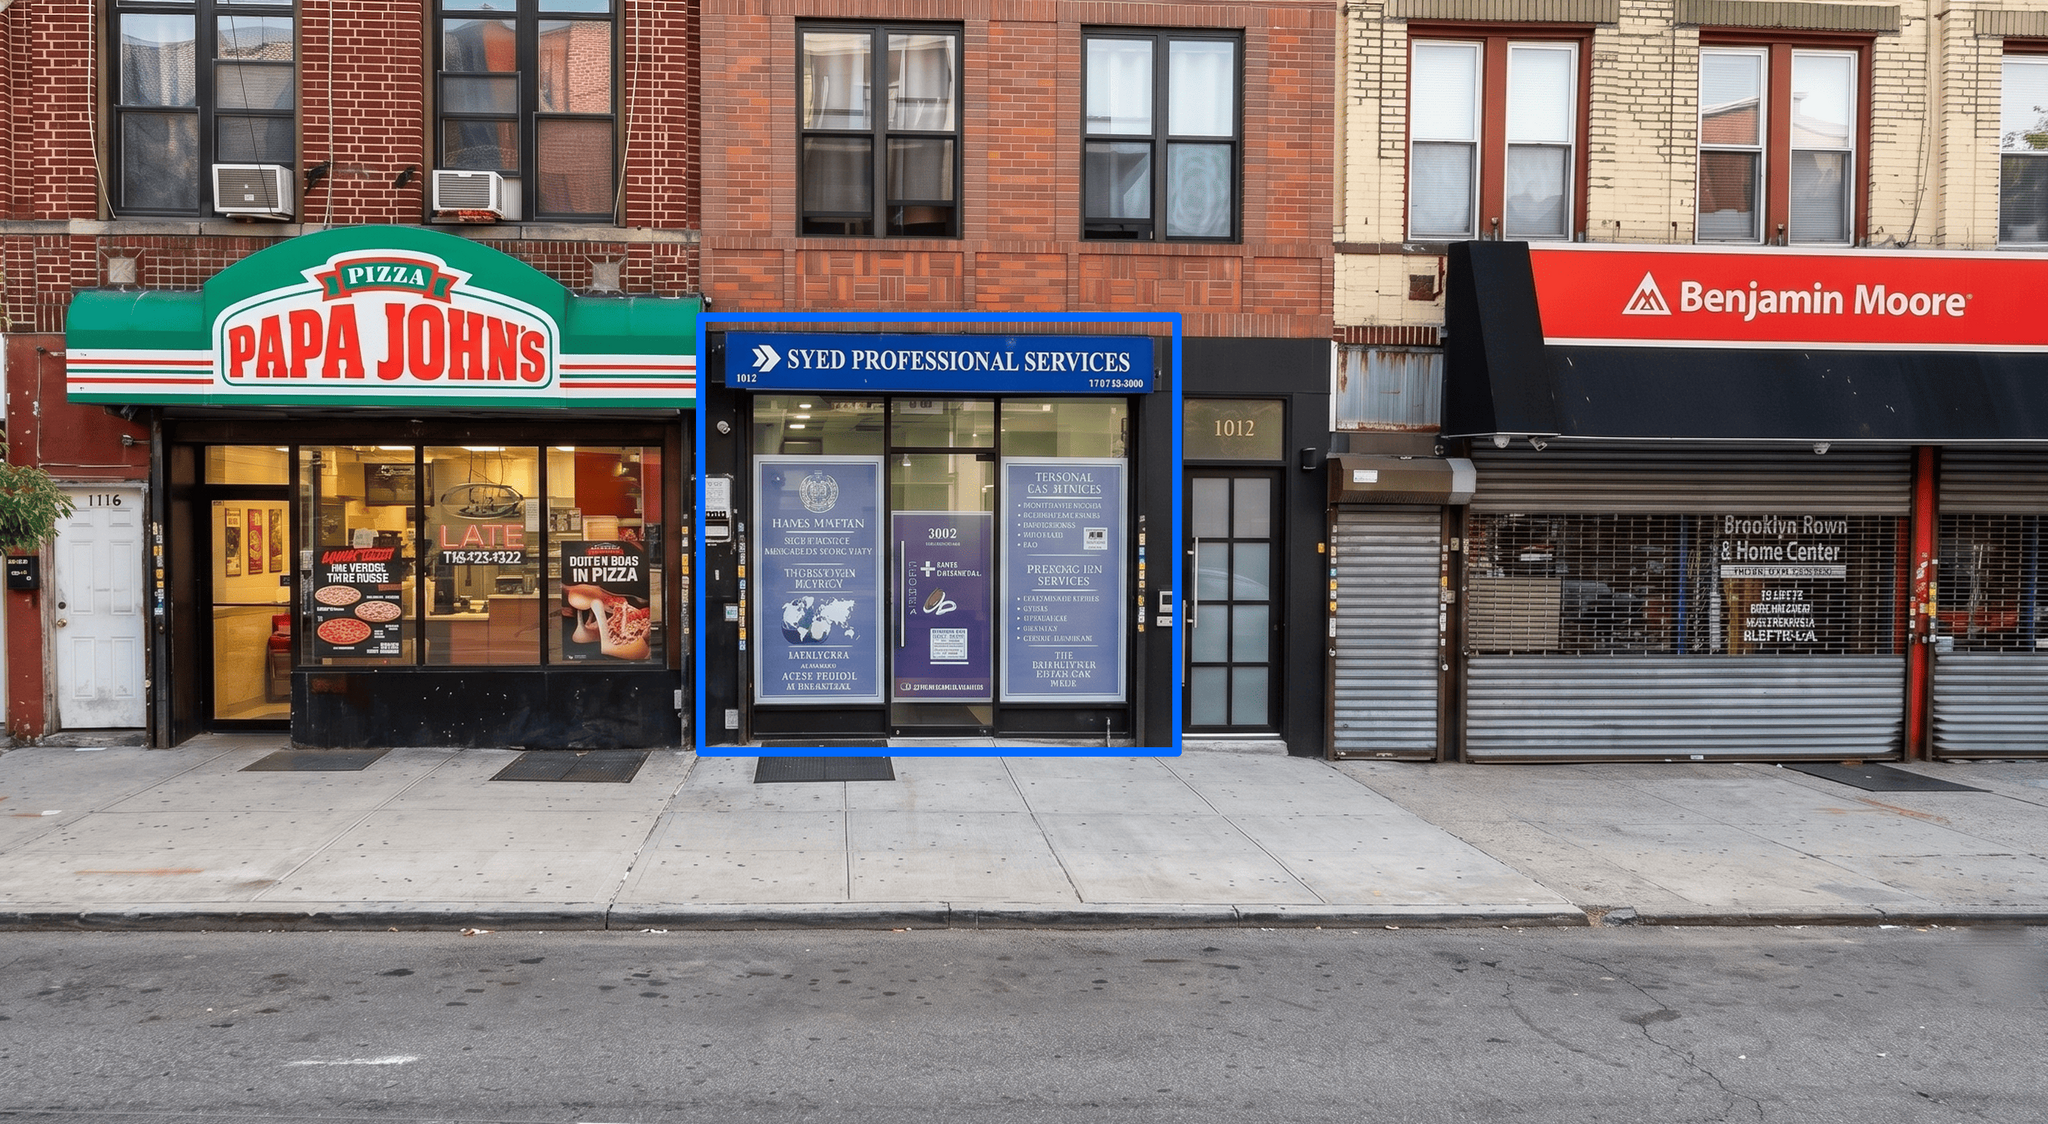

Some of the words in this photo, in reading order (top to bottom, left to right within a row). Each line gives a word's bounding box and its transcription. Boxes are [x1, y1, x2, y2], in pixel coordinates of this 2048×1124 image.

[347, 266, 426, 287] PIZZA
[1680, 280, 1844, 322] Benjamin
[1853, 284, 1967, 317] Moore
[228, 303, 366, 380] PAPA
[377, 302, 546, 383] JOHN'S
[787, 348, 846, 370] SYED
[851, 349, 1019, 372] PROFESSIONAL
[1024, 351, 1131, 373] SERVICES
[736, 373, 758, 383] 1012
[1214, 419, 1255, 437] 1012
[89, 494, 122, 507] 1116
[928, 527, 957, 539] 3002
[1724, 514, 1797, 540] Brooklyn
[1803, 515, 1848, 535] Rown
[440, 524, 525, 550] LATE
[1721, 540, 1732, 560] &
[1736, 540, 1783, 561] Home
[1786, 541, 1840, 561] Center
[611, 555, 639, 566] BOAS
[573, 568, 589, 582] IN
[592, 567, 639, 582] PIZZA
[1037, 576, 1090, 586] SERVICES
